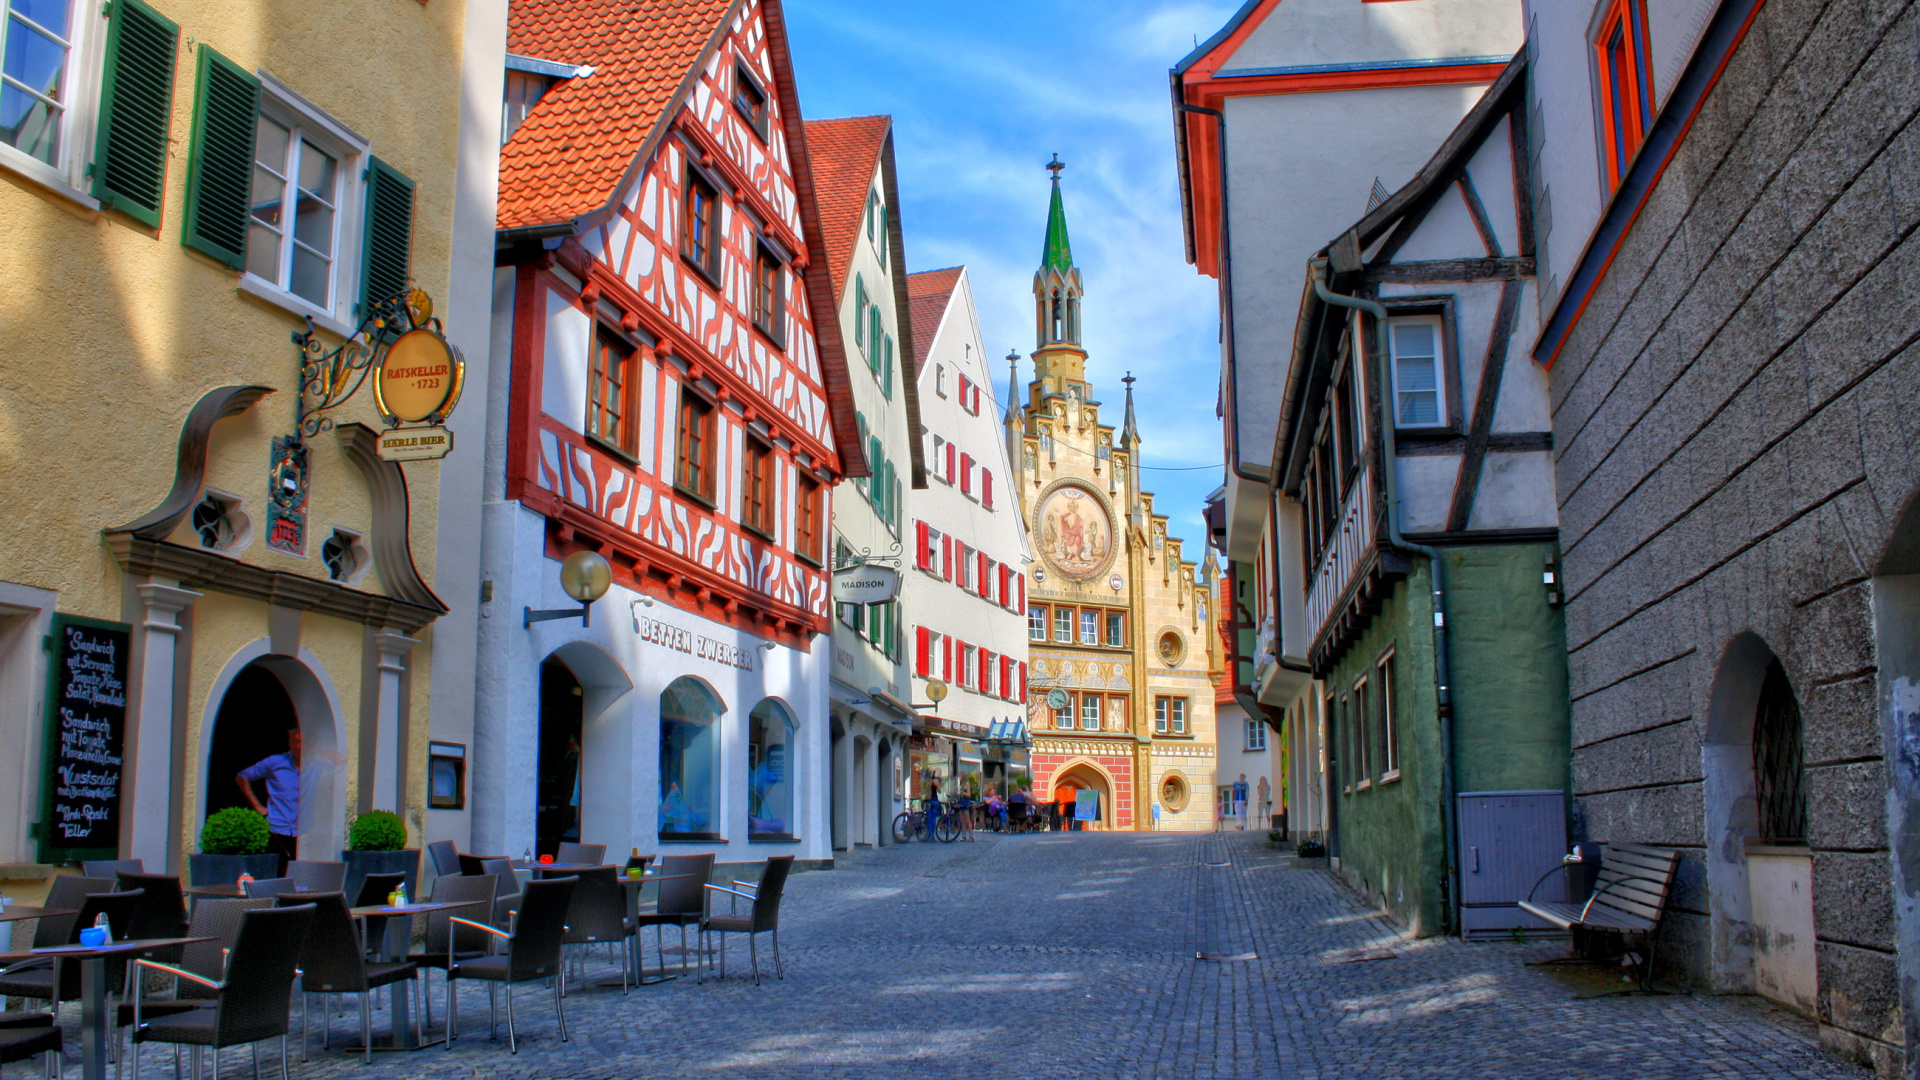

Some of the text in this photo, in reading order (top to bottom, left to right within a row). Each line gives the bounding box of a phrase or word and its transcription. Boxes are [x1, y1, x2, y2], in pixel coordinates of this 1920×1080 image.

[387, 364, 448, 380] RATSKELLER
[417, 378, 440, 390] 1723
[419, 435, 445, 446] BIER
[841, 580, 884, 589] MADISON
[70, 631, 115, 663] Sandwich
[641, 615, 753, 672] BETTEN ZWERGER
[62, 709, 112, 740] Sandwich
[61, 728, 77, 746] mit
